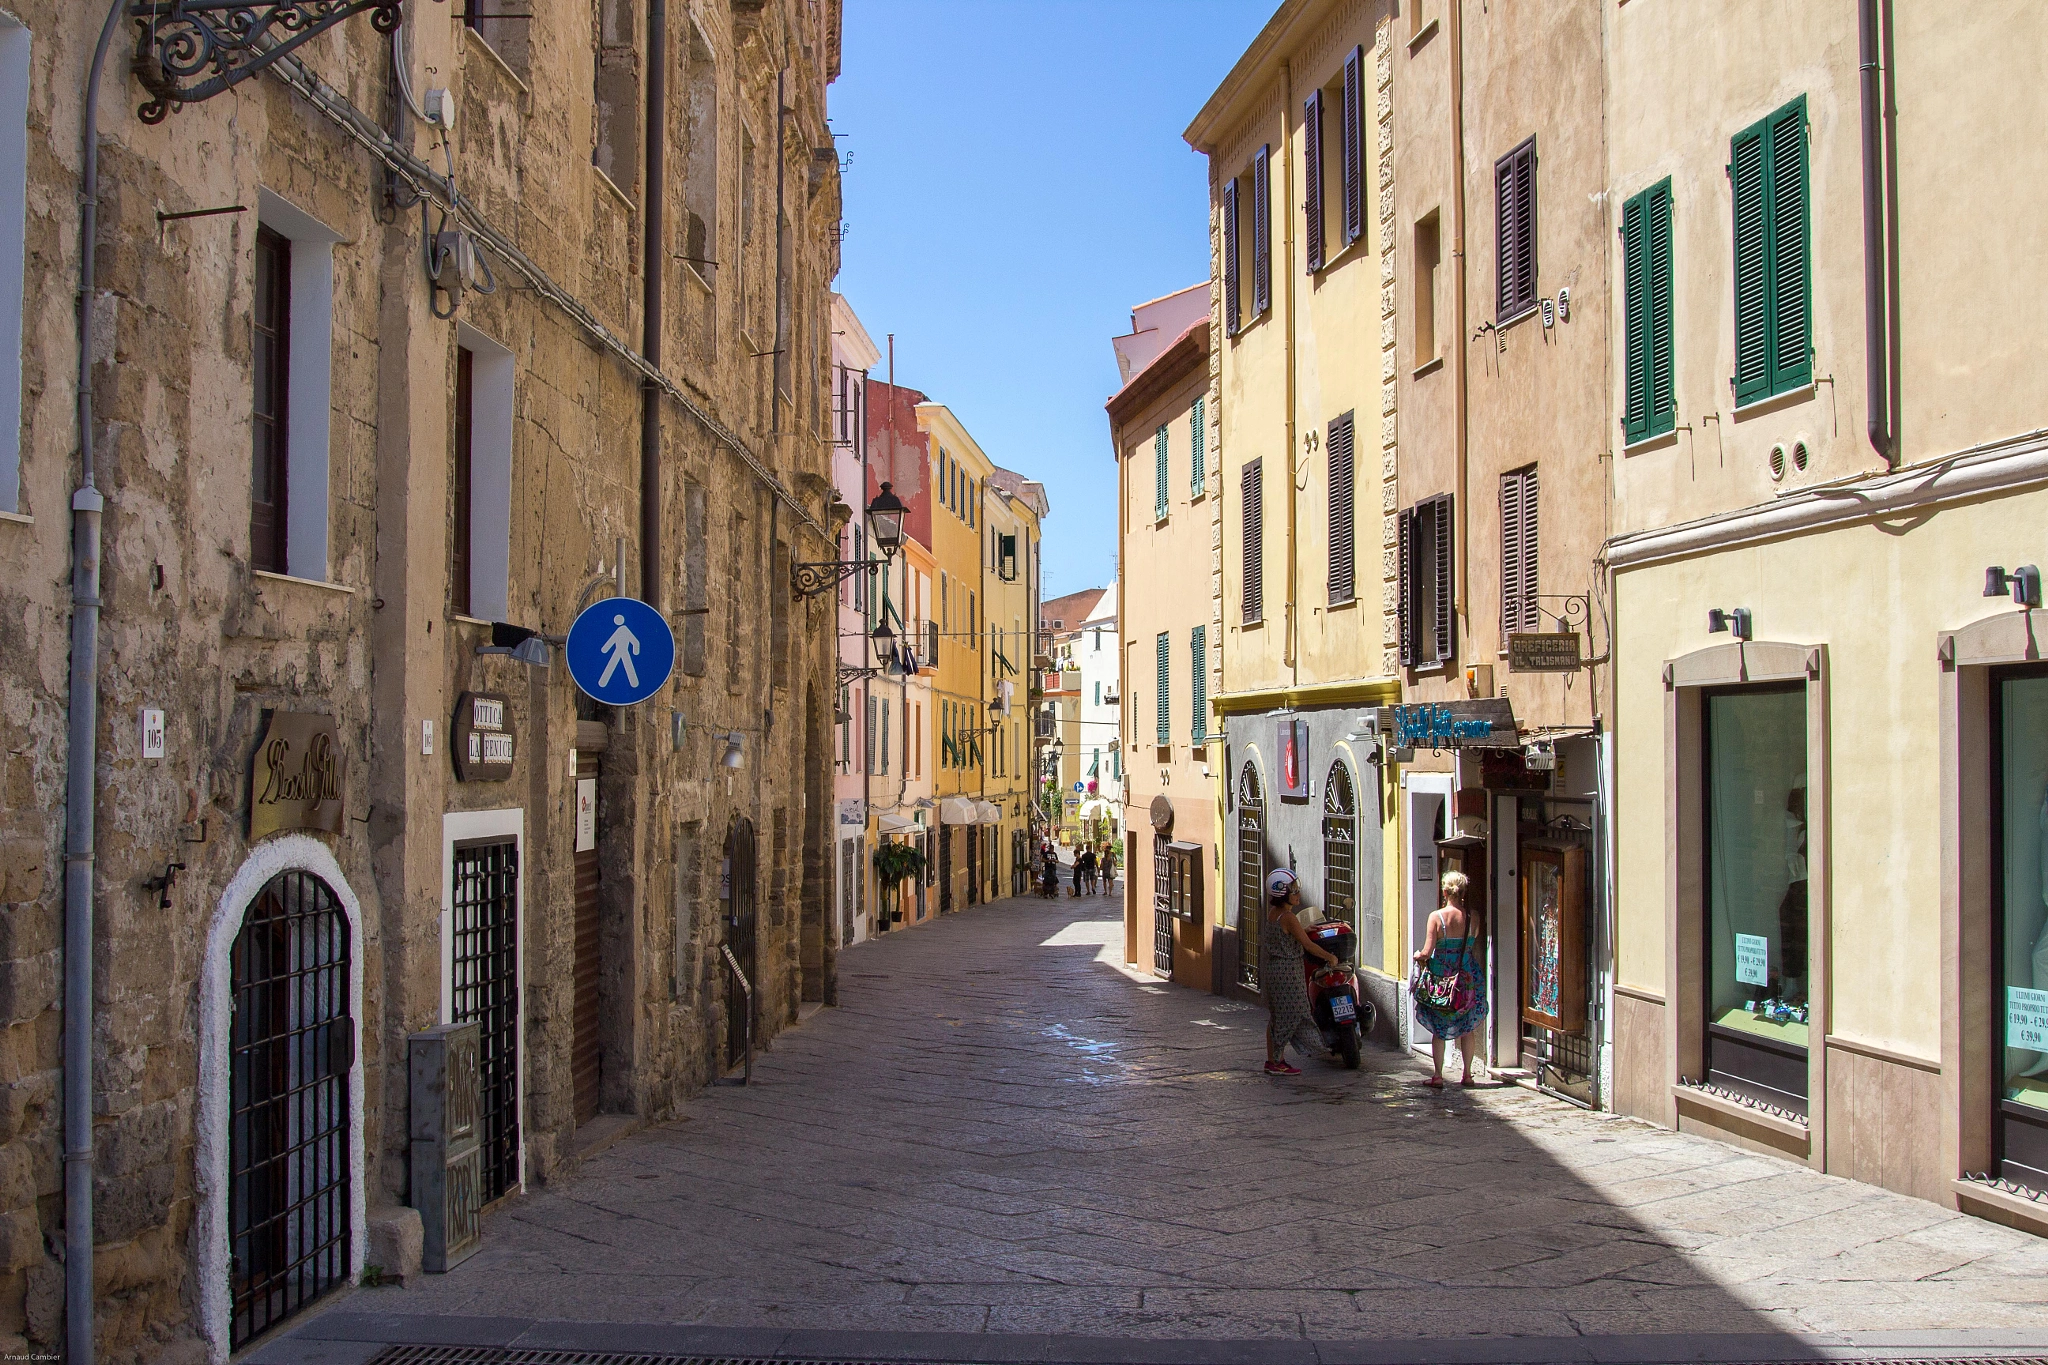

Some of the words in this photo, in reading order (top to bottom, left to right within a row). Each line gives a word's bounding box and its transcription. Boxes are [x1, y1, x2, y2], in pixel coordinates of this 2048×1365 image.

[1513, 639, 1576, 653] OREFICERIA
[1514, 656, 1525, 666] IL
[1529, 655, 1577, 666] TALISMANO
[474, 704, 503, 725] OTTICA
[147, 729, 162, 749] 105
[470, 739, 480, 758] LA
[484, 739, 512, 758] FENICE
[1334, 1005, 1353, 1015] 32213
[2021, 1029, 2025, 1041] €
